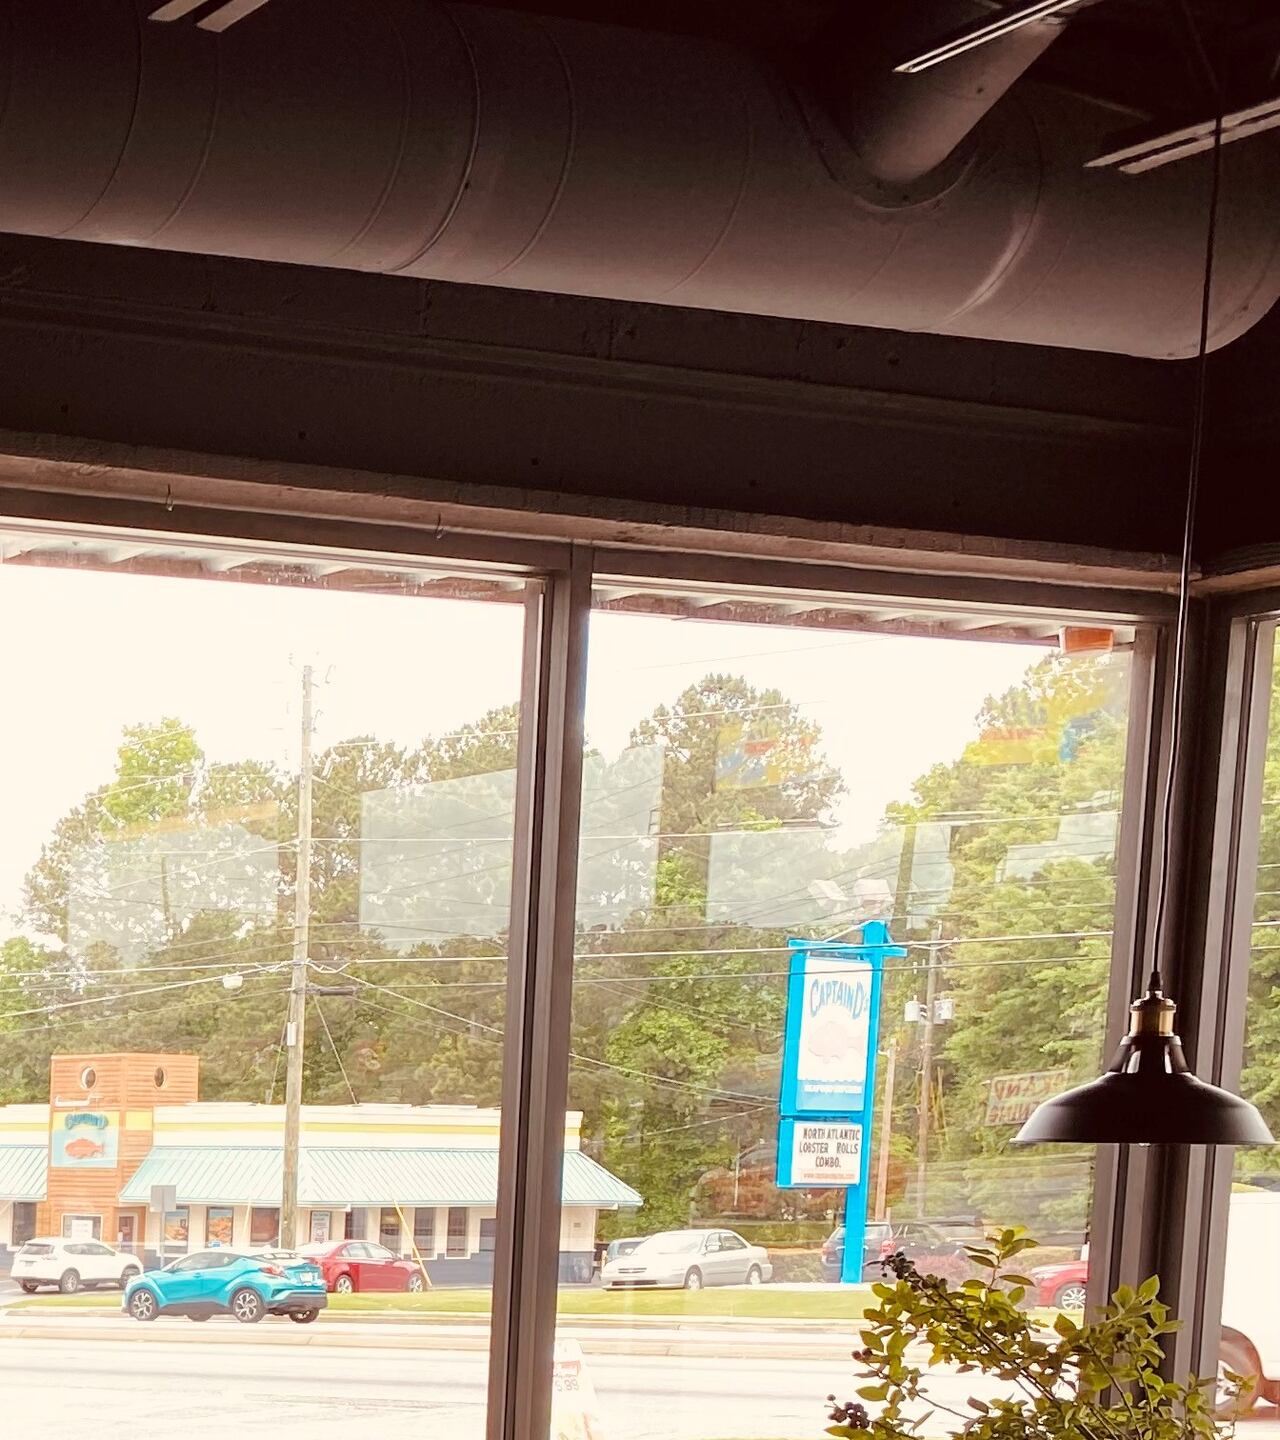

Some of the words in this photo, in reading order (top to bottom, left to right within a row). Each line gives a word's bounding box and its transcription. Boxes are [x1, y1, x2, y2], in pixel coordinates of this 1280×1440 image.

[810, 979, 852, 1017] CAPTAIN
[803, 1128, 825, 1139] NORTH
[827, 1129, 860, 1140] ATLANTIC
[799, 1142, 829, 1153] LOBSTER
[836, 1142, 859, 1154] ROLLS
